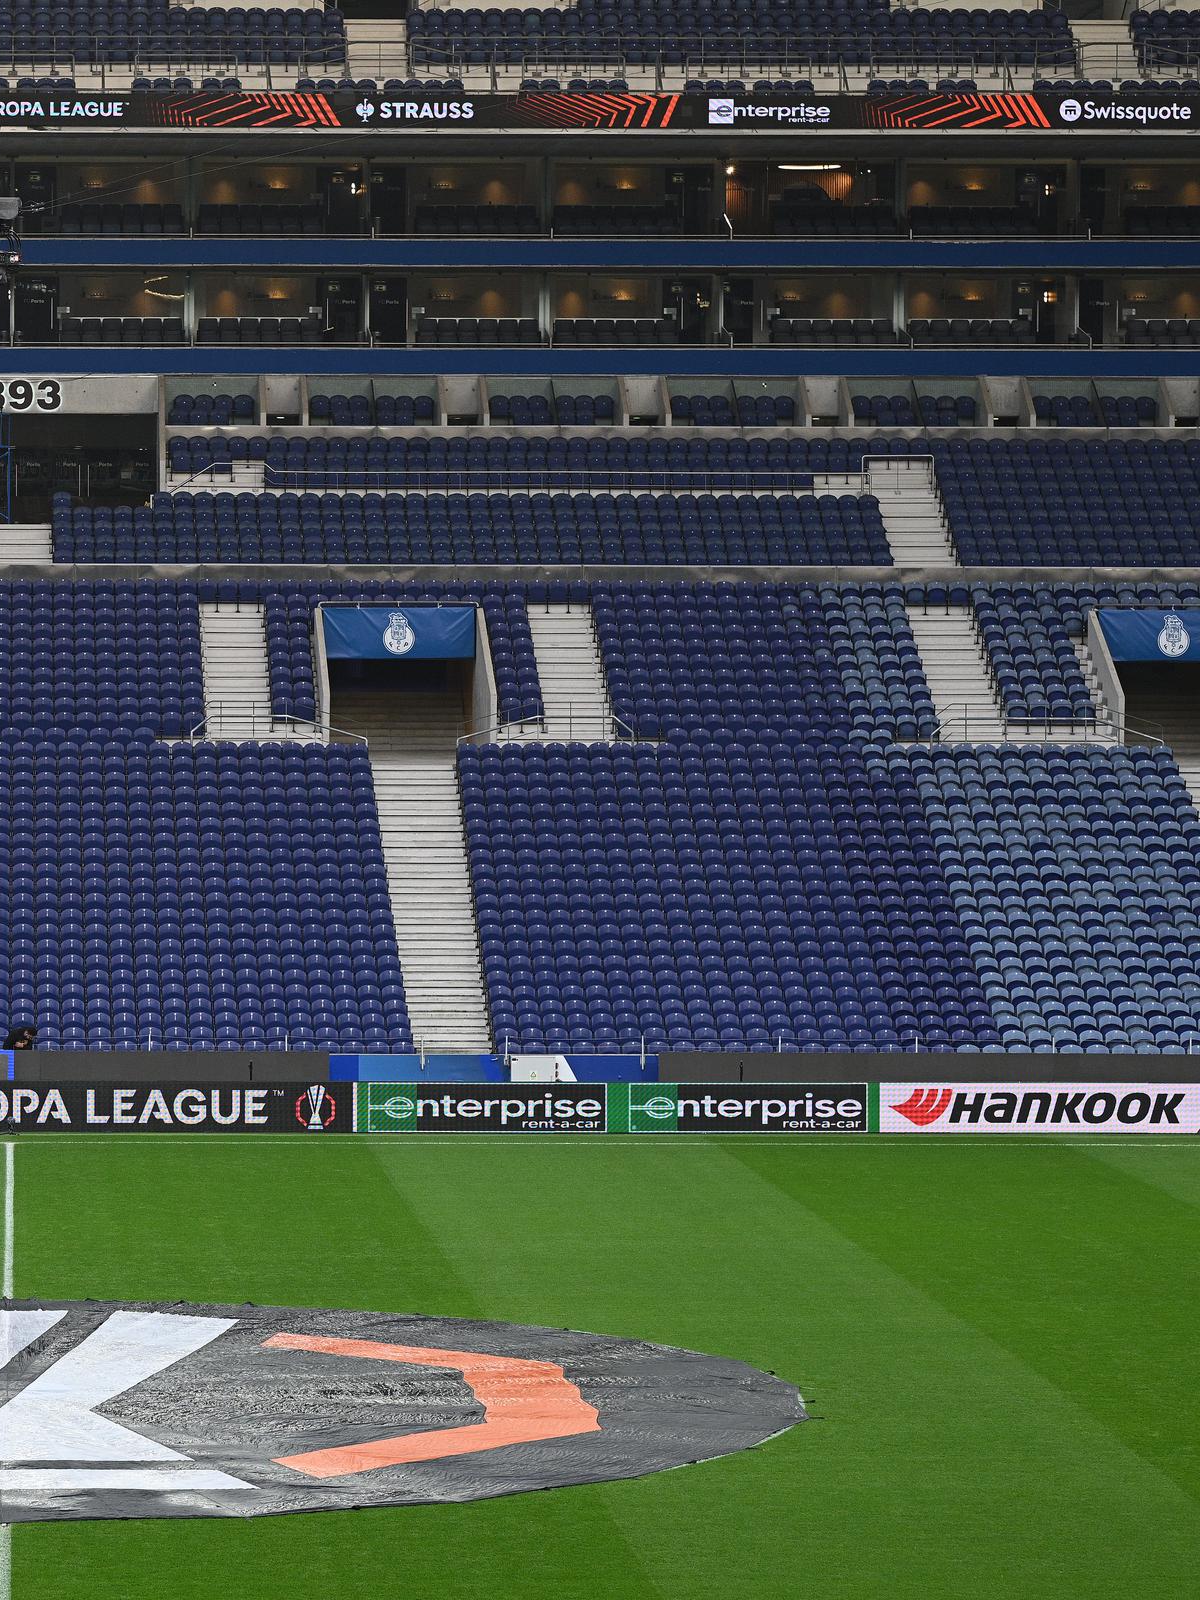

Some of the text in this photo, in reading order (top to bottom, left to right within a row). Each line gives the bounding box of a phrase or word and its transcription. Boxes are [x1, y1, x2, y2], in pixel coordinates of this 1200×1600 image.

[380, 101, 474, 119] STRAUSS
[1083, 101, 1192, 124] Swissquote
[86, 1088, 269, 1125] LEAGUE
[384, 1092, 602, 1125] enterprise
[644, 1092, 863, 1125] enterprise
[521, 1119, 601, 1129] rent-a-car
[782, 1119, 862, 1129] rent-a-car
